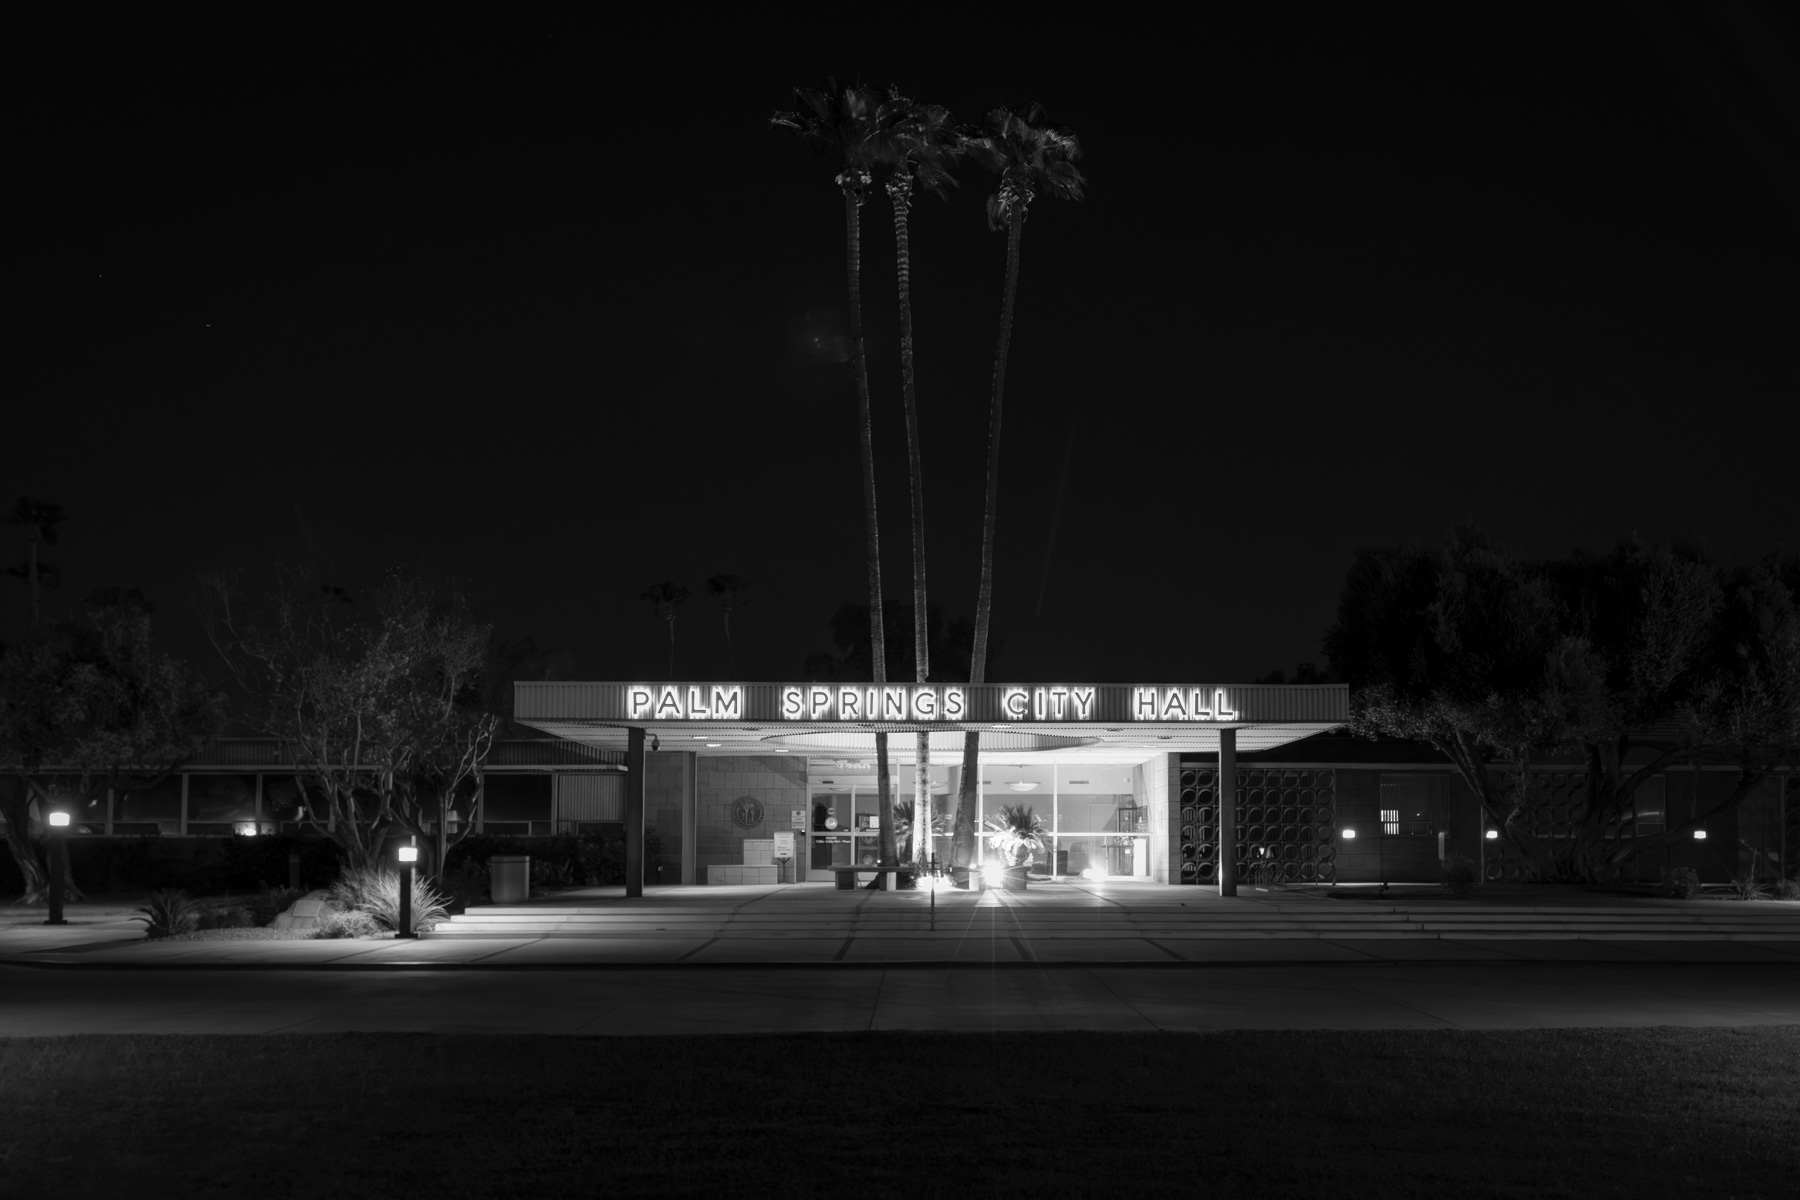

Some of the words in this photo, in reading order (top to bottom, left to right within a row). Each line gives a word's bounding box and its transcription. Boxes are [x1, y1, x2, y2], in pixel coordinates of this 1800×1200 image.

[632, 690, 739, 715] PALM
[785, 690, 962, 715] SPRINGS
[1006, 691, 1093, 716] CITY
[1138, 691, 1235, 716] HALL
